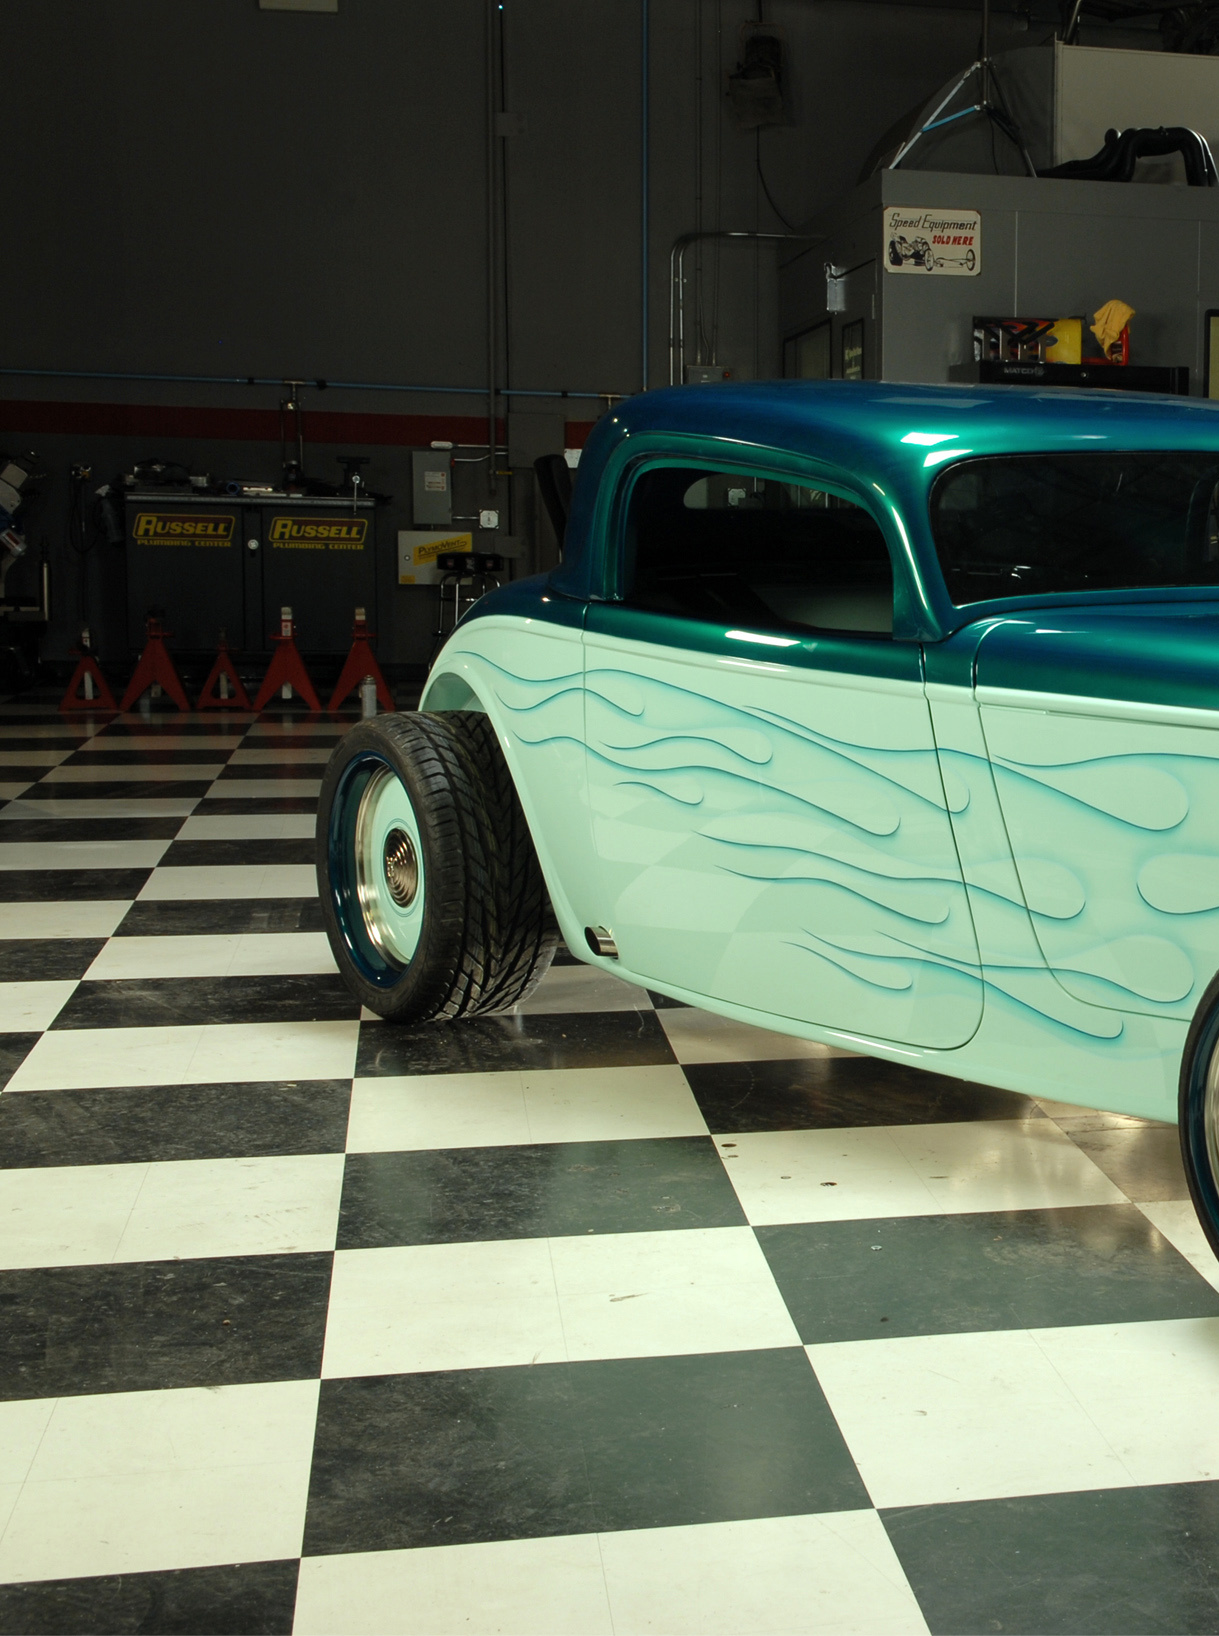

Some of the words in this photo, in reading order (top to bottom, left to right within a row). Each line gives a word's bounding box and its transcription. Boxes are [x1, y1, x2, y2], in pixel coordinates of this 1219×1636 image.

[889, 212, 921, 231] Speed
[922, 214, 977, 233] Equipment
[932, 235, 951, 245] SOLD
[951, 236, 974, 246] HERE
[136, 516, 229, 536] RUSSELL
[273, 520, 361, 539] RUSSELL
